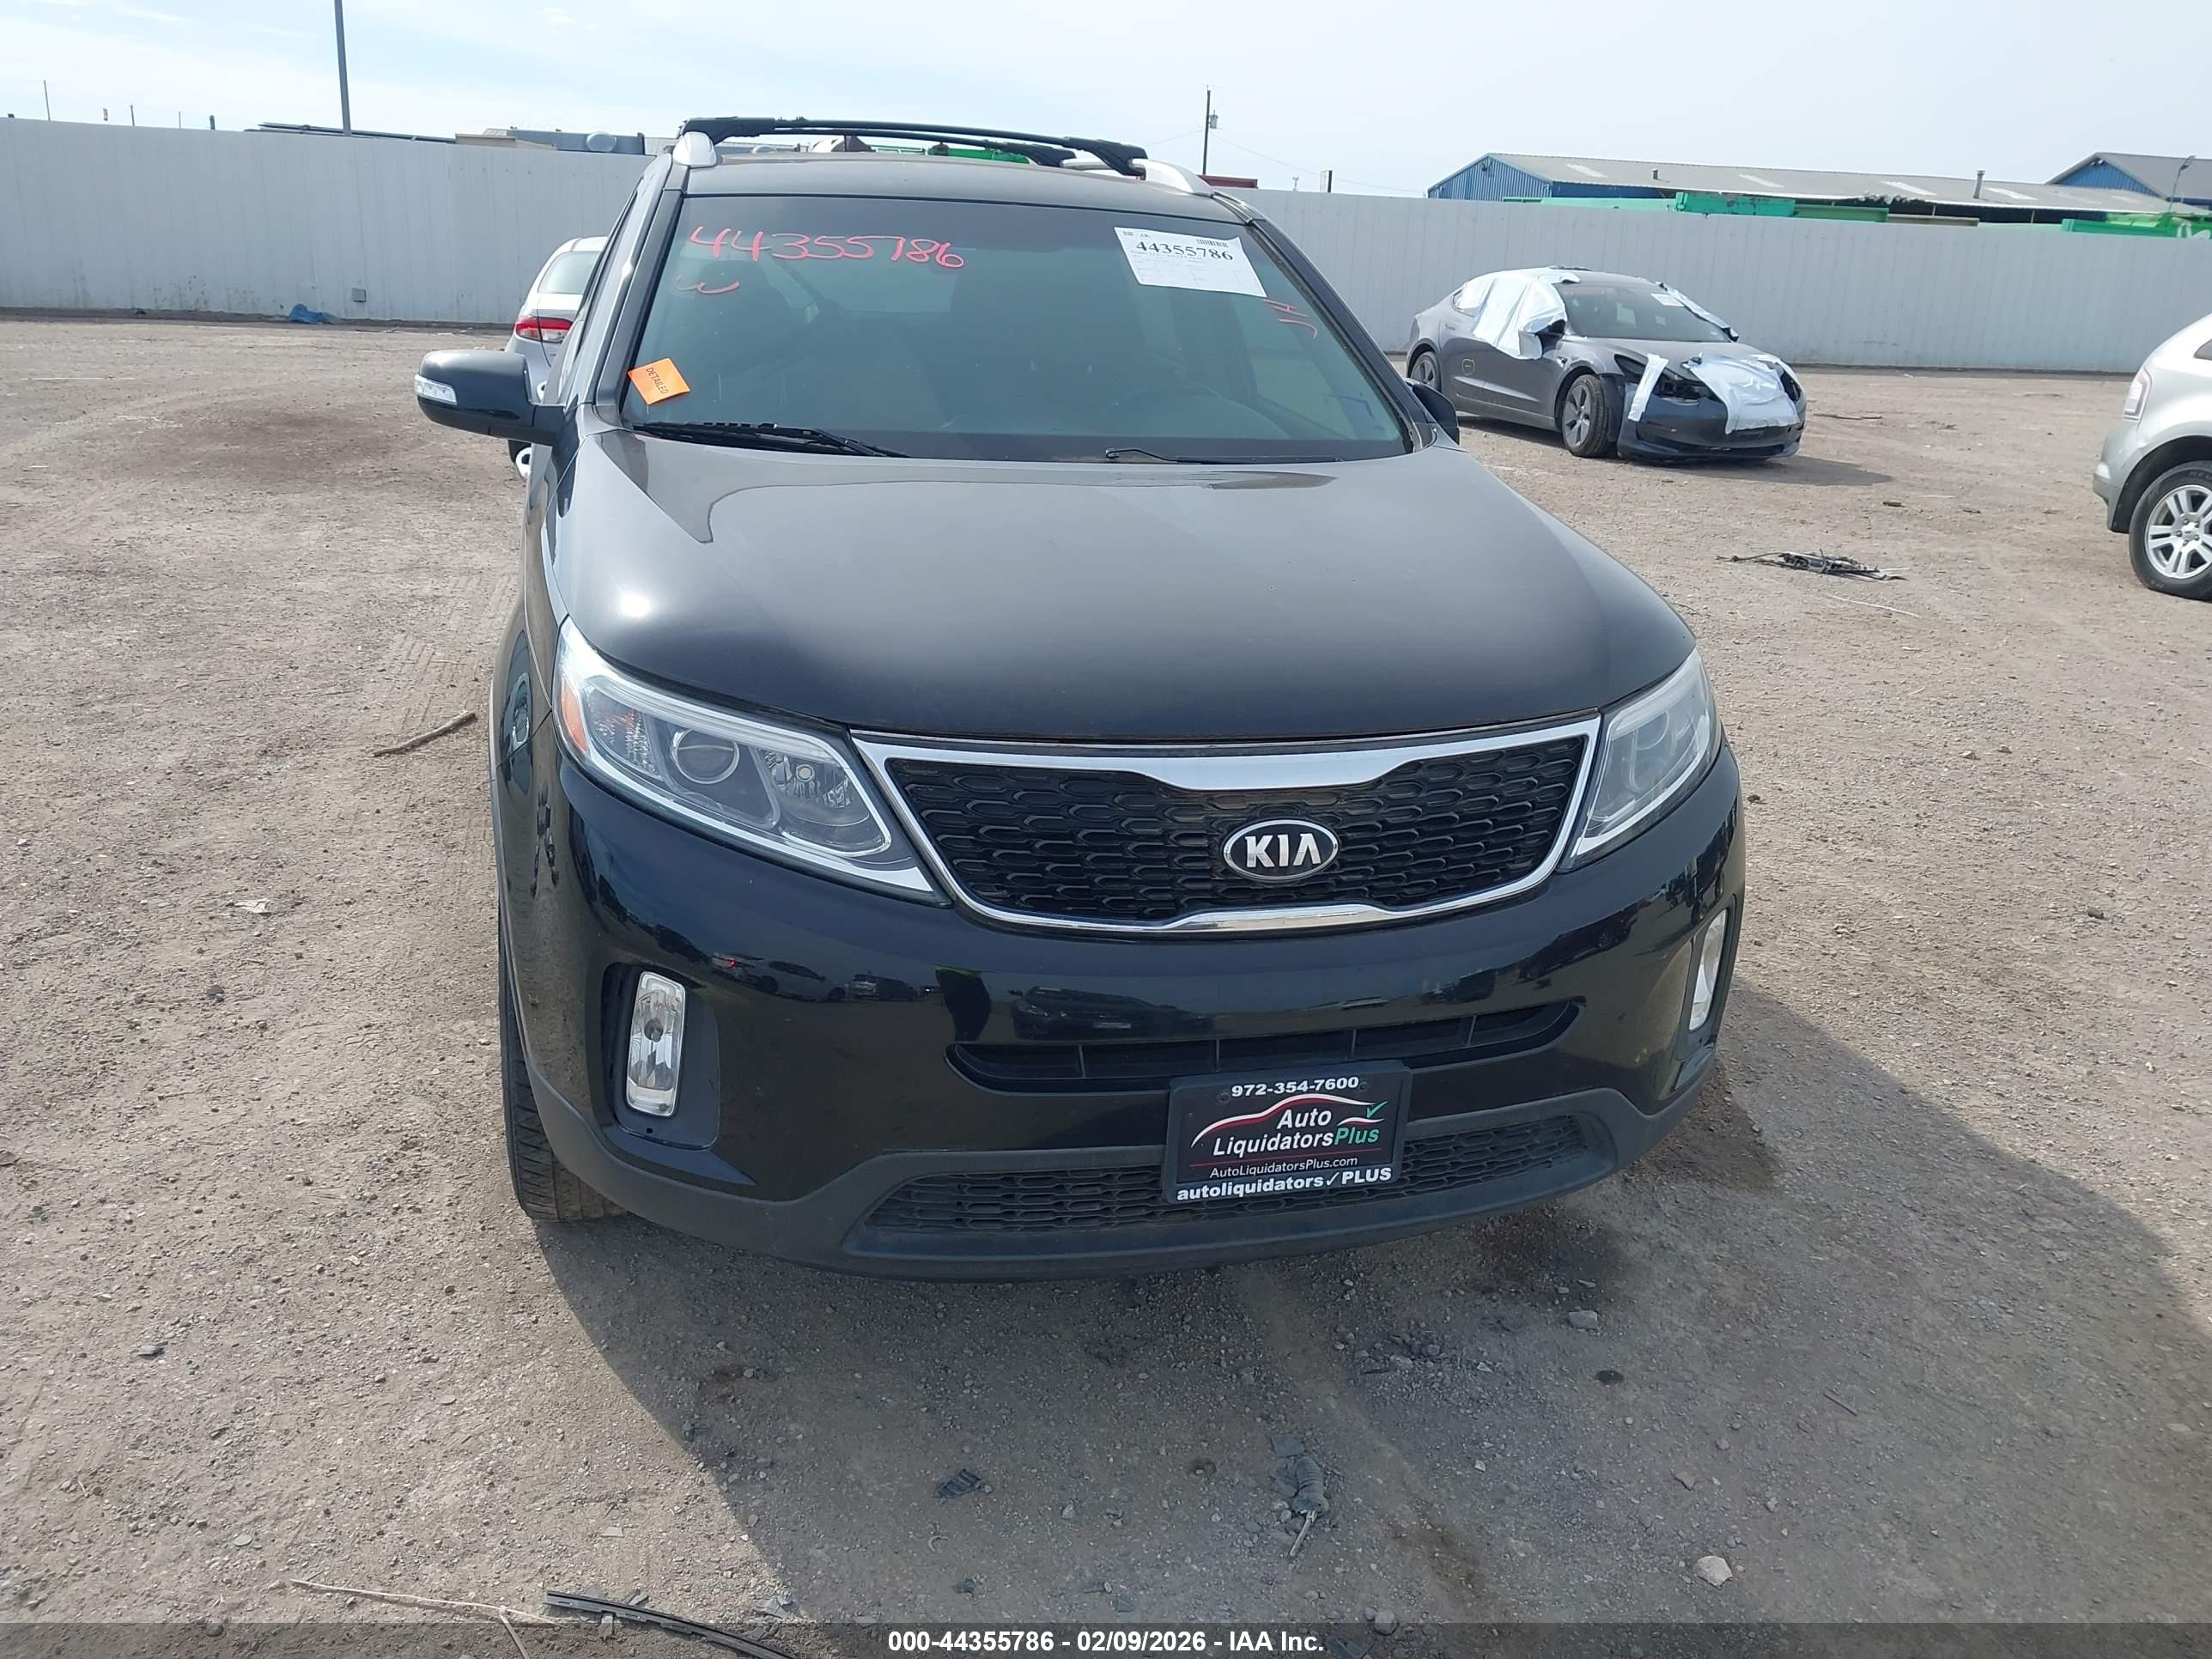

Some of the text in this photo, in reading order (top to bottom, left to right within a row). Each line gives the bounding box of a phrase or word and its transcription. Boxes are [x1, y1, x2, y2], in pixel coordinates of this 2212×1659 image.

[689, 225, 965, 268] 44355786
[1136, 240, 1234, 261] 44355786
[646, 367, 669, 394] DETAILED
[1245, 833, 1322, 868] KIA
[1231, 1077, 1359, 1097] 972-354-7600
[1276, 1109, 1332, 1130] Auto
[1209, 1156, 1358, 1179] AutoLiquidatorsPlus.com
[1341, 1167, 1392, 1184] PLUS
